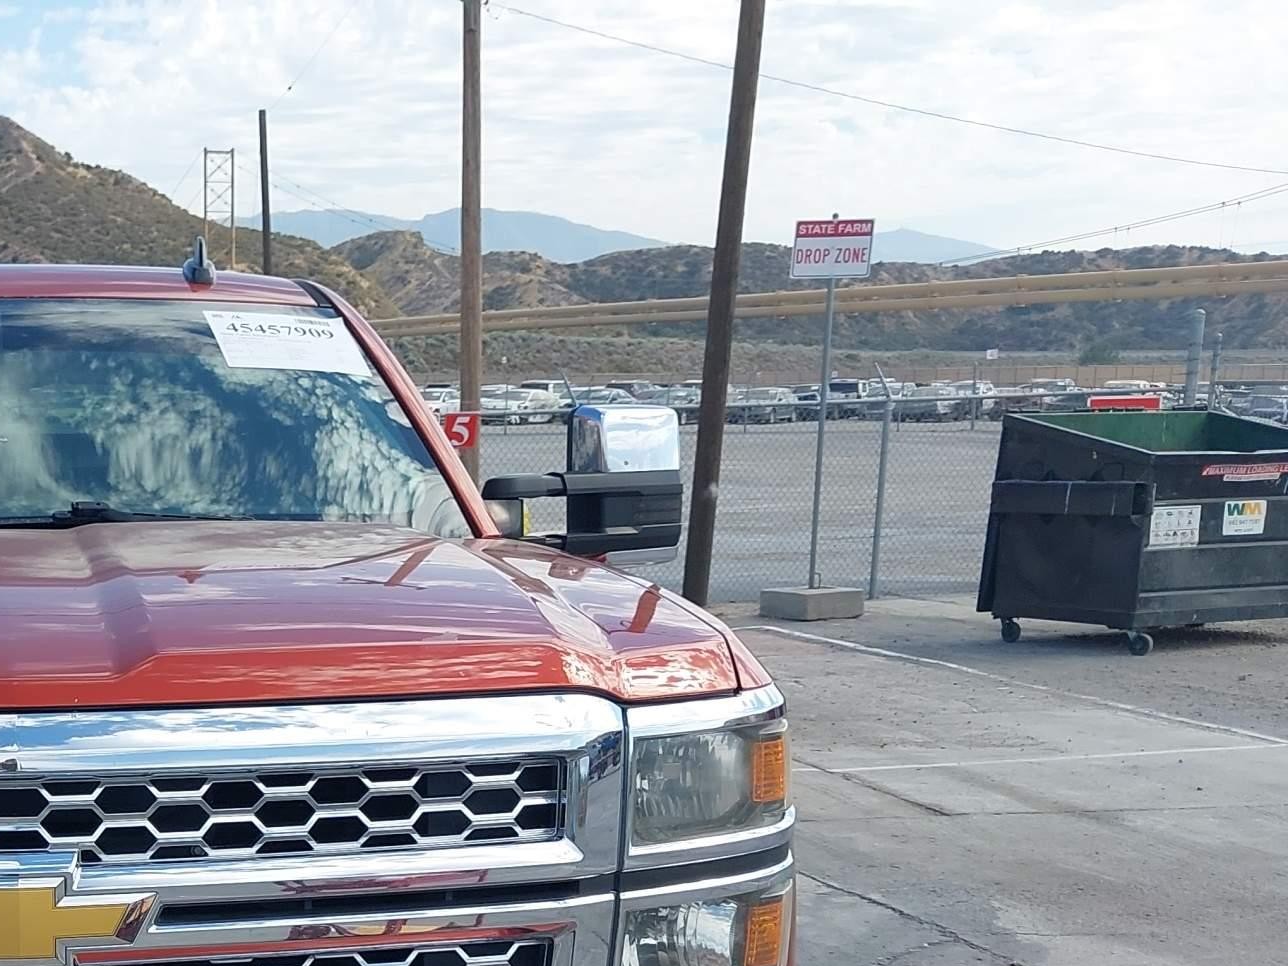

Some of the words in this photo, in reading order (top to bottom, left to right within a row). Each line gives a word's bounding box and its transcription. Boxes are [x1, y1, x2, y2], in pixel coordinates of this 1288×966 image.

[798, 223, 835, 235] STATE
[838, 222, 872, 234] FARM
[795, 247, 831, 265] DROP
[834, 247, 869, 264] ZONE
[225, 322, 335, 340] 45457909
[451, 415, 472, 447] 5
[1227, 503, 1262, 516] WM
